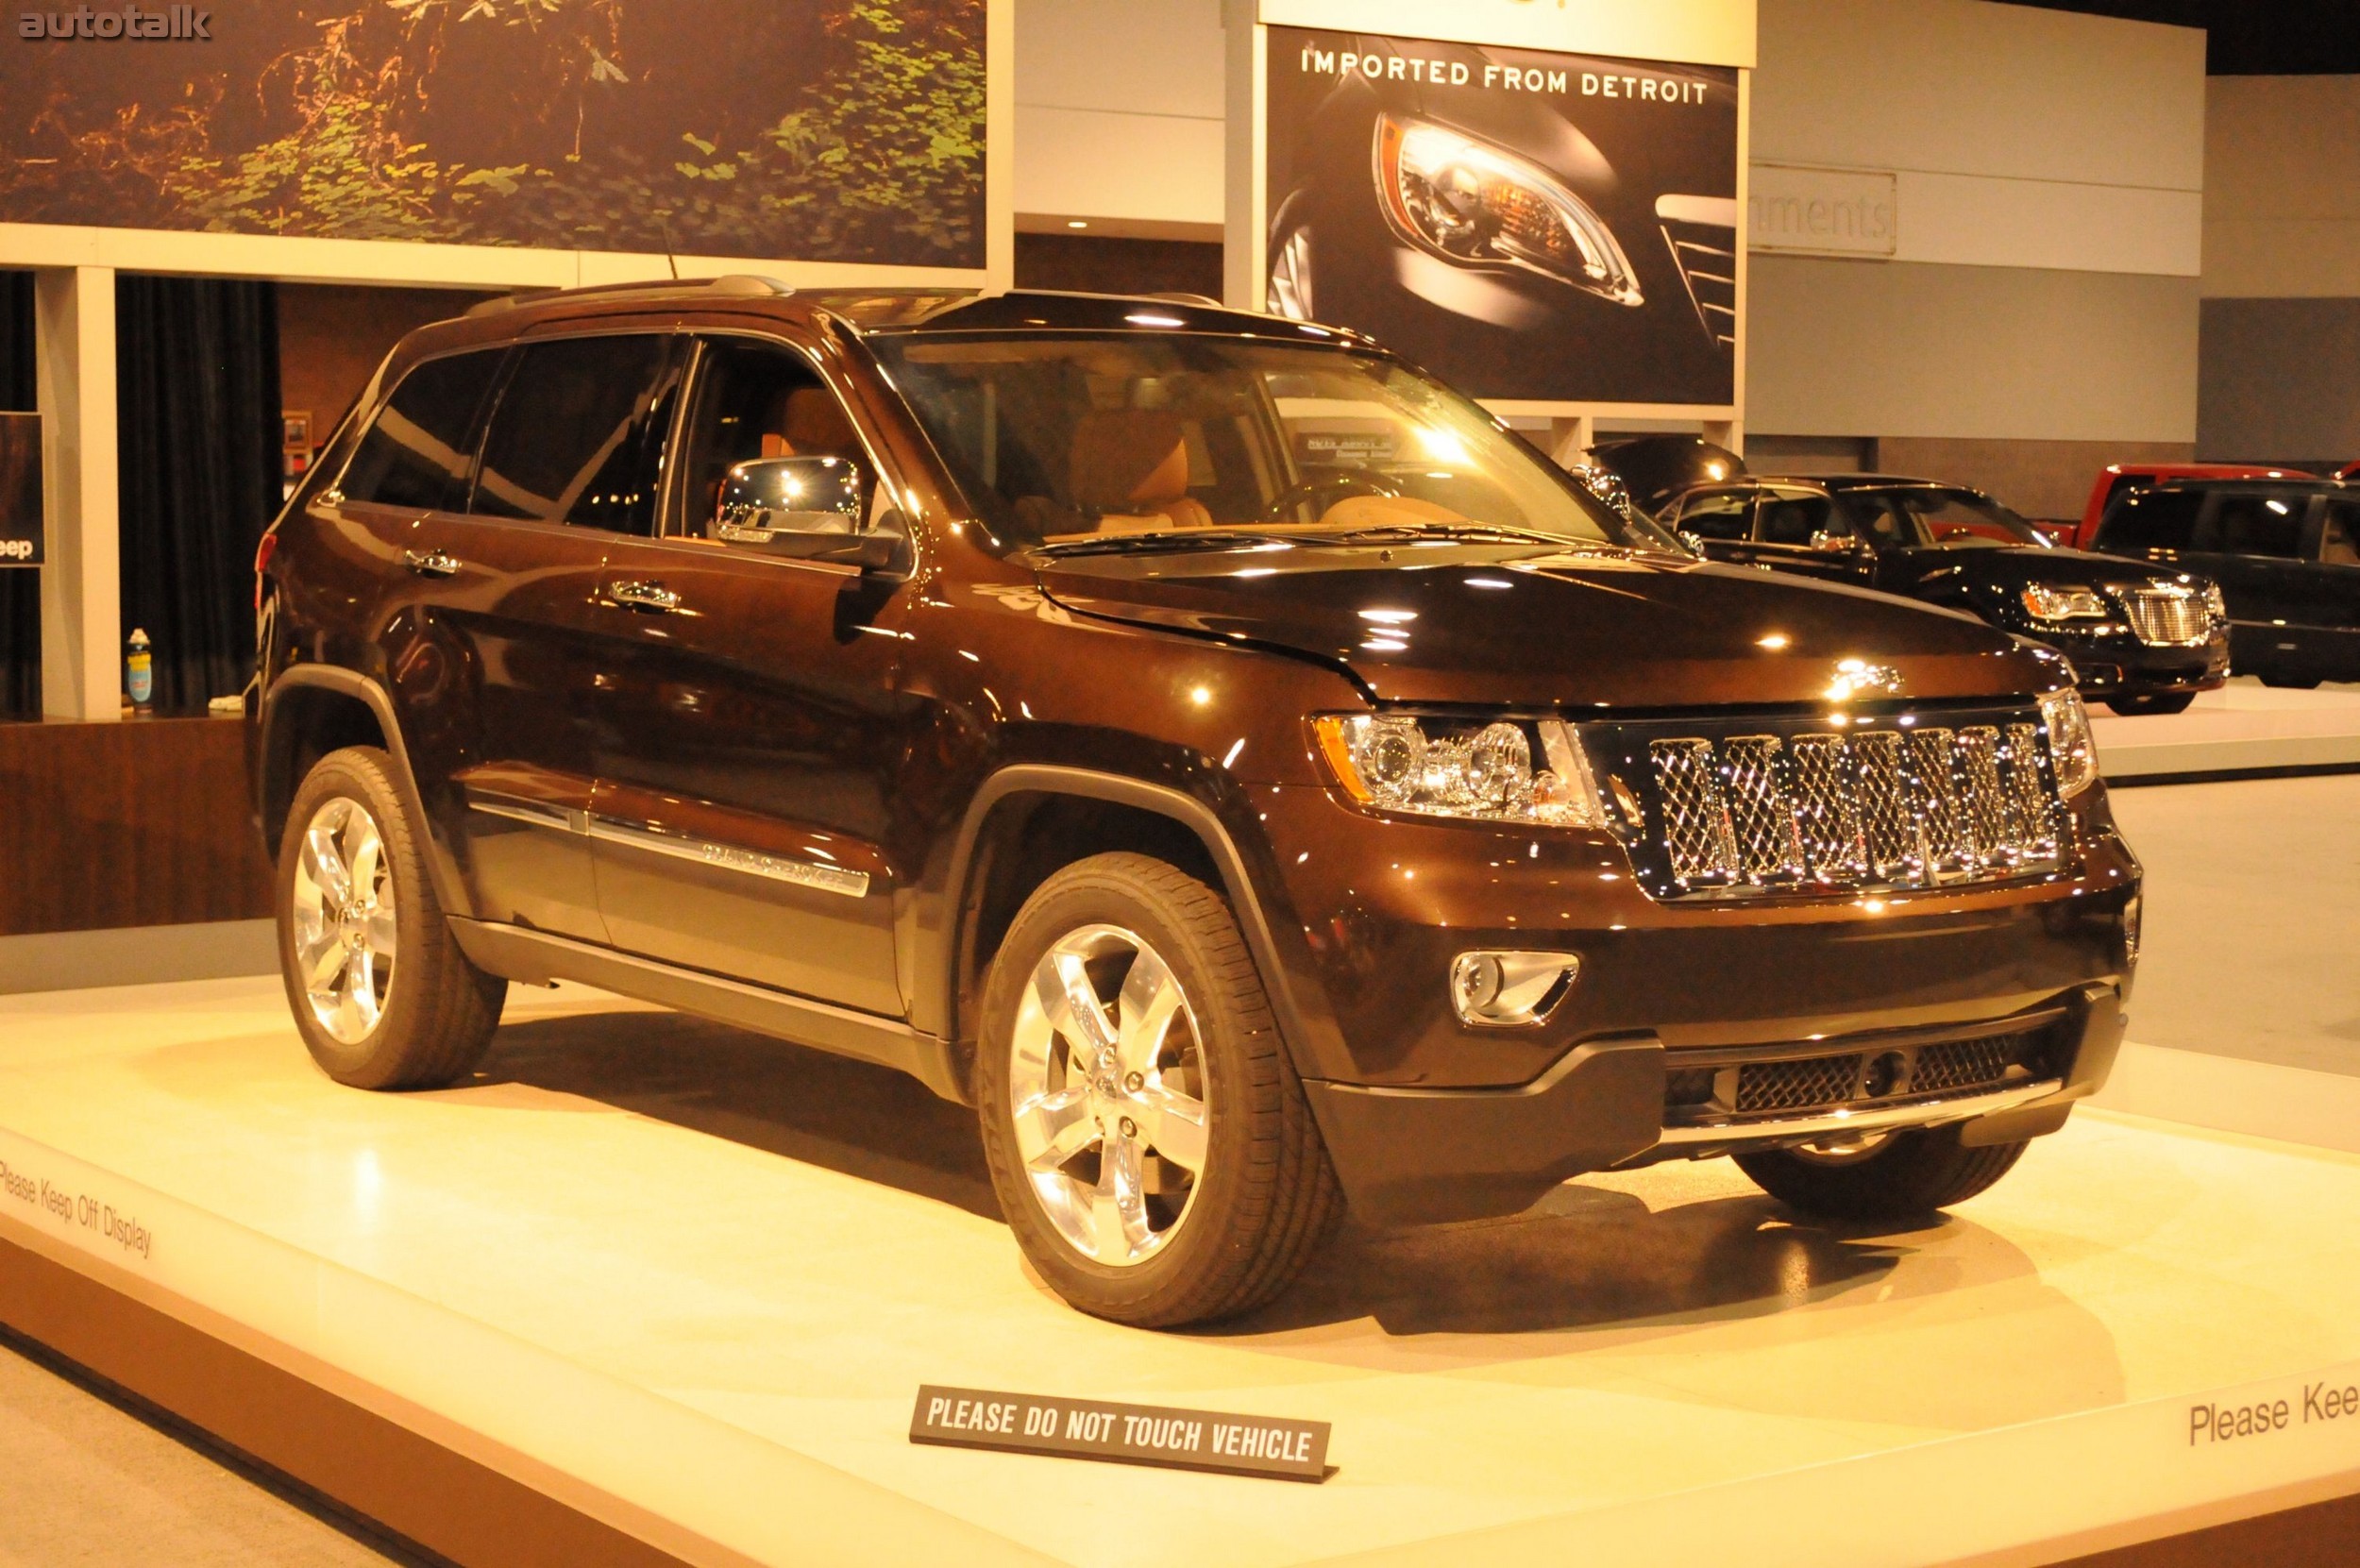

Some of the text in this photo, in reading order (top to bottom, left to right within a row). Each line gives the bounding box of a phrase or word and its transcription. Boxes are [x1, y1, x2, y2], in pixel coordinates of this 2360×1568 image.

[1301, 49, 1708, 105] IMPORTED FROM DETROIT
[41, 1178, 73, 1223] Keep
[78, 1194, 98, 1230] Off
[104, 1205, 151, 1259] Display
[926, 1397, 1312, 1463] PLEASE DO NOT TOUCH VEHICLE
[2190, 1381, 2360, 1446] Please Kee
